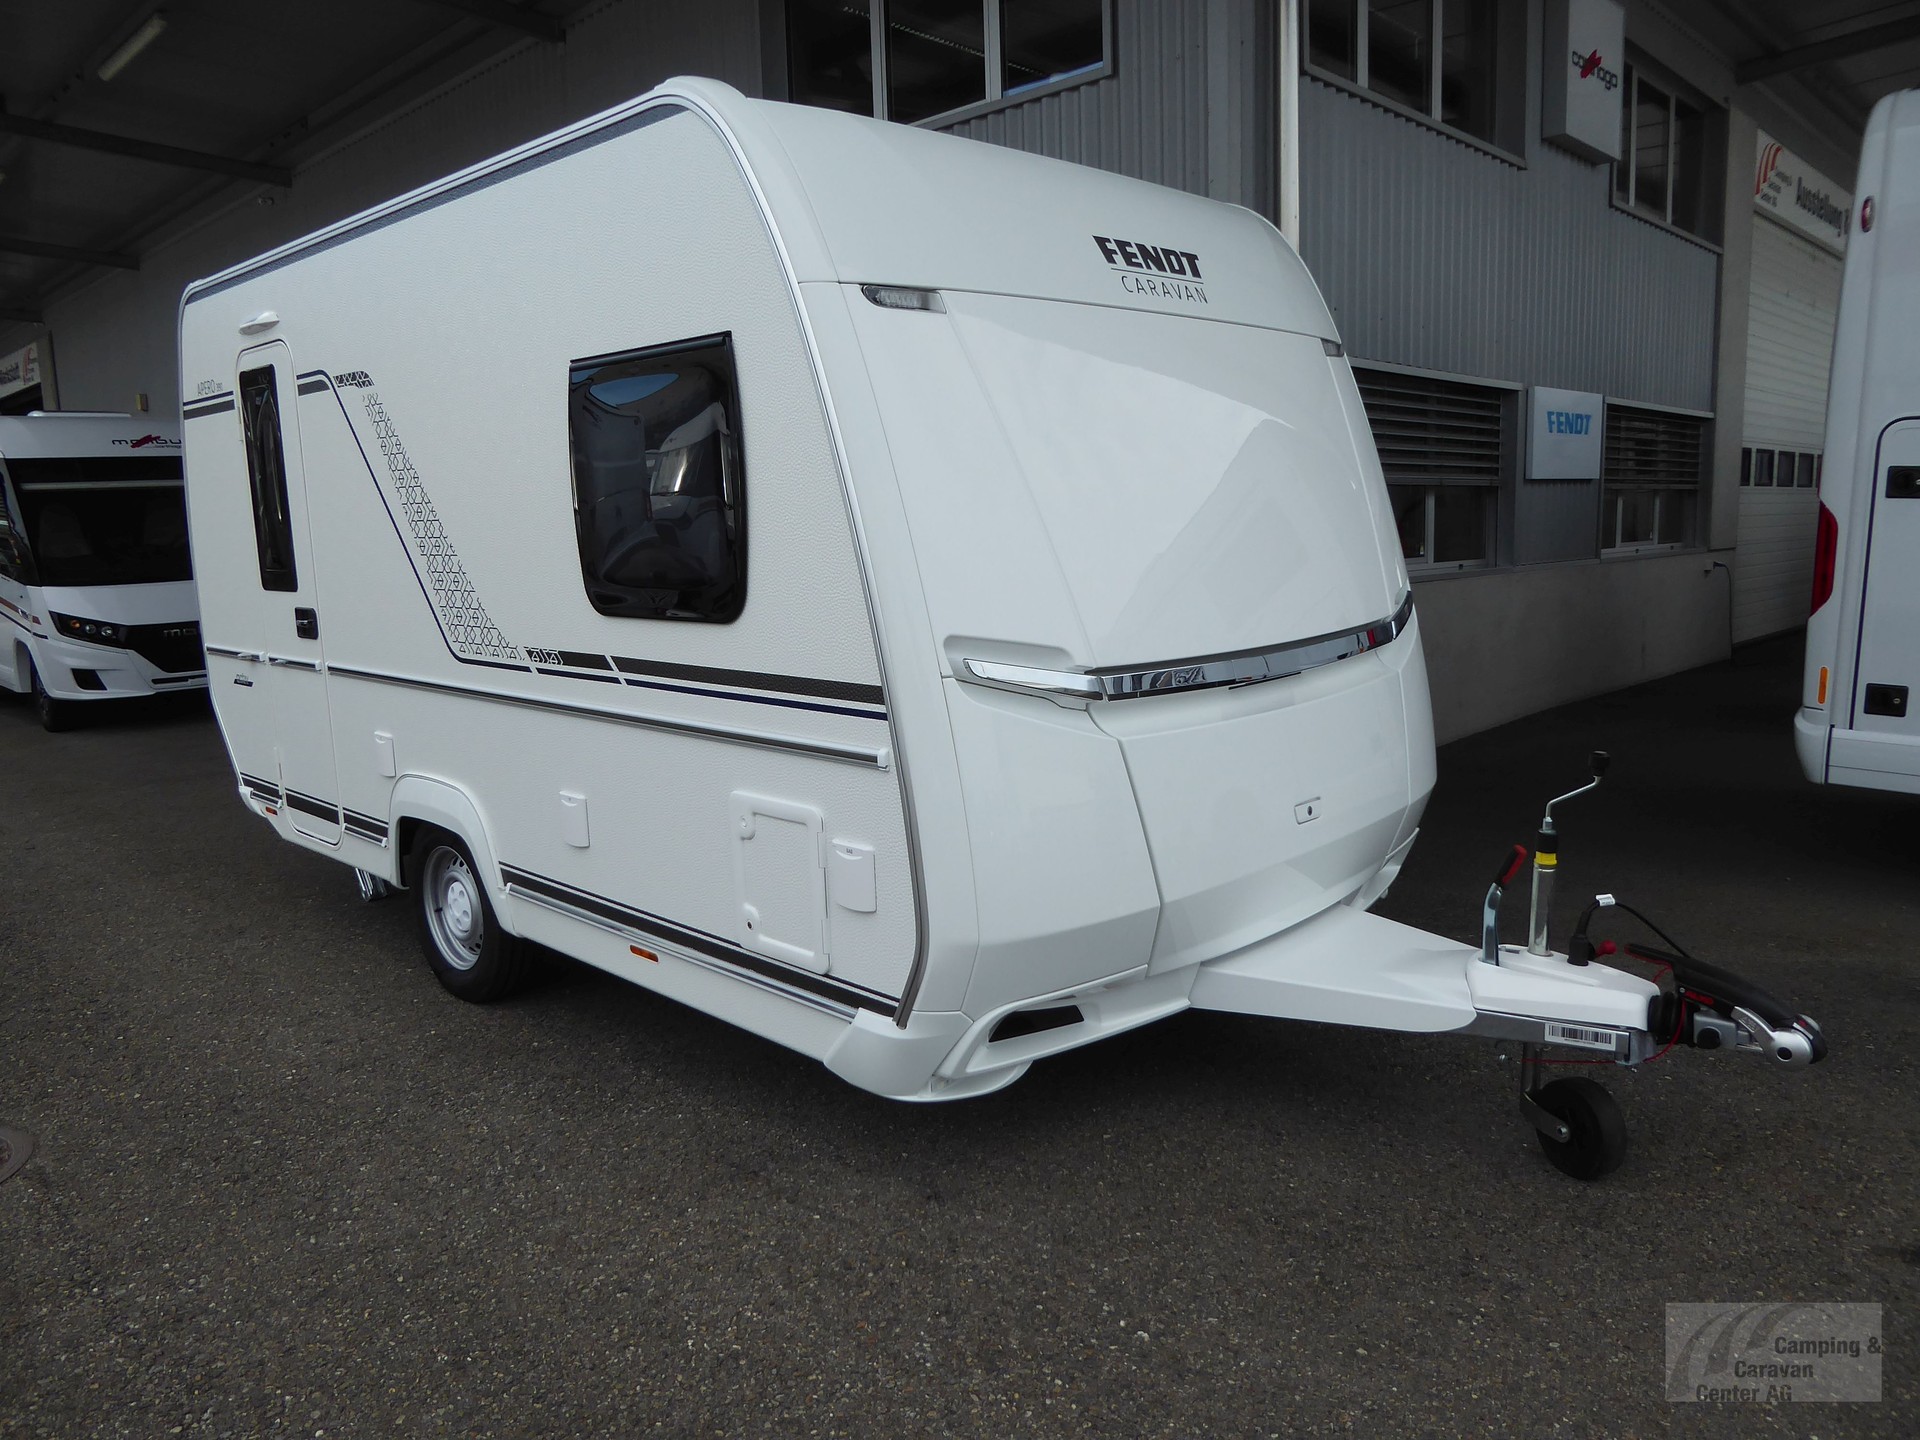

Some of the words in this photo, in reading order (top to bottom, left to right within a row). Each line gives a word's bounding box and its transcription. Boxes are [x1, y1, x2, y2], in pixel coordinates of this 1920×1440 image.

[1572, 50, 1618, 91] cahago
[1092, 235, 1202, 279] FENDT
[1121, 275, 1208, 304] CARAVAN
[1546, 411, 1592, 435] FENDT
[112, 436, 182, 446] mabu
